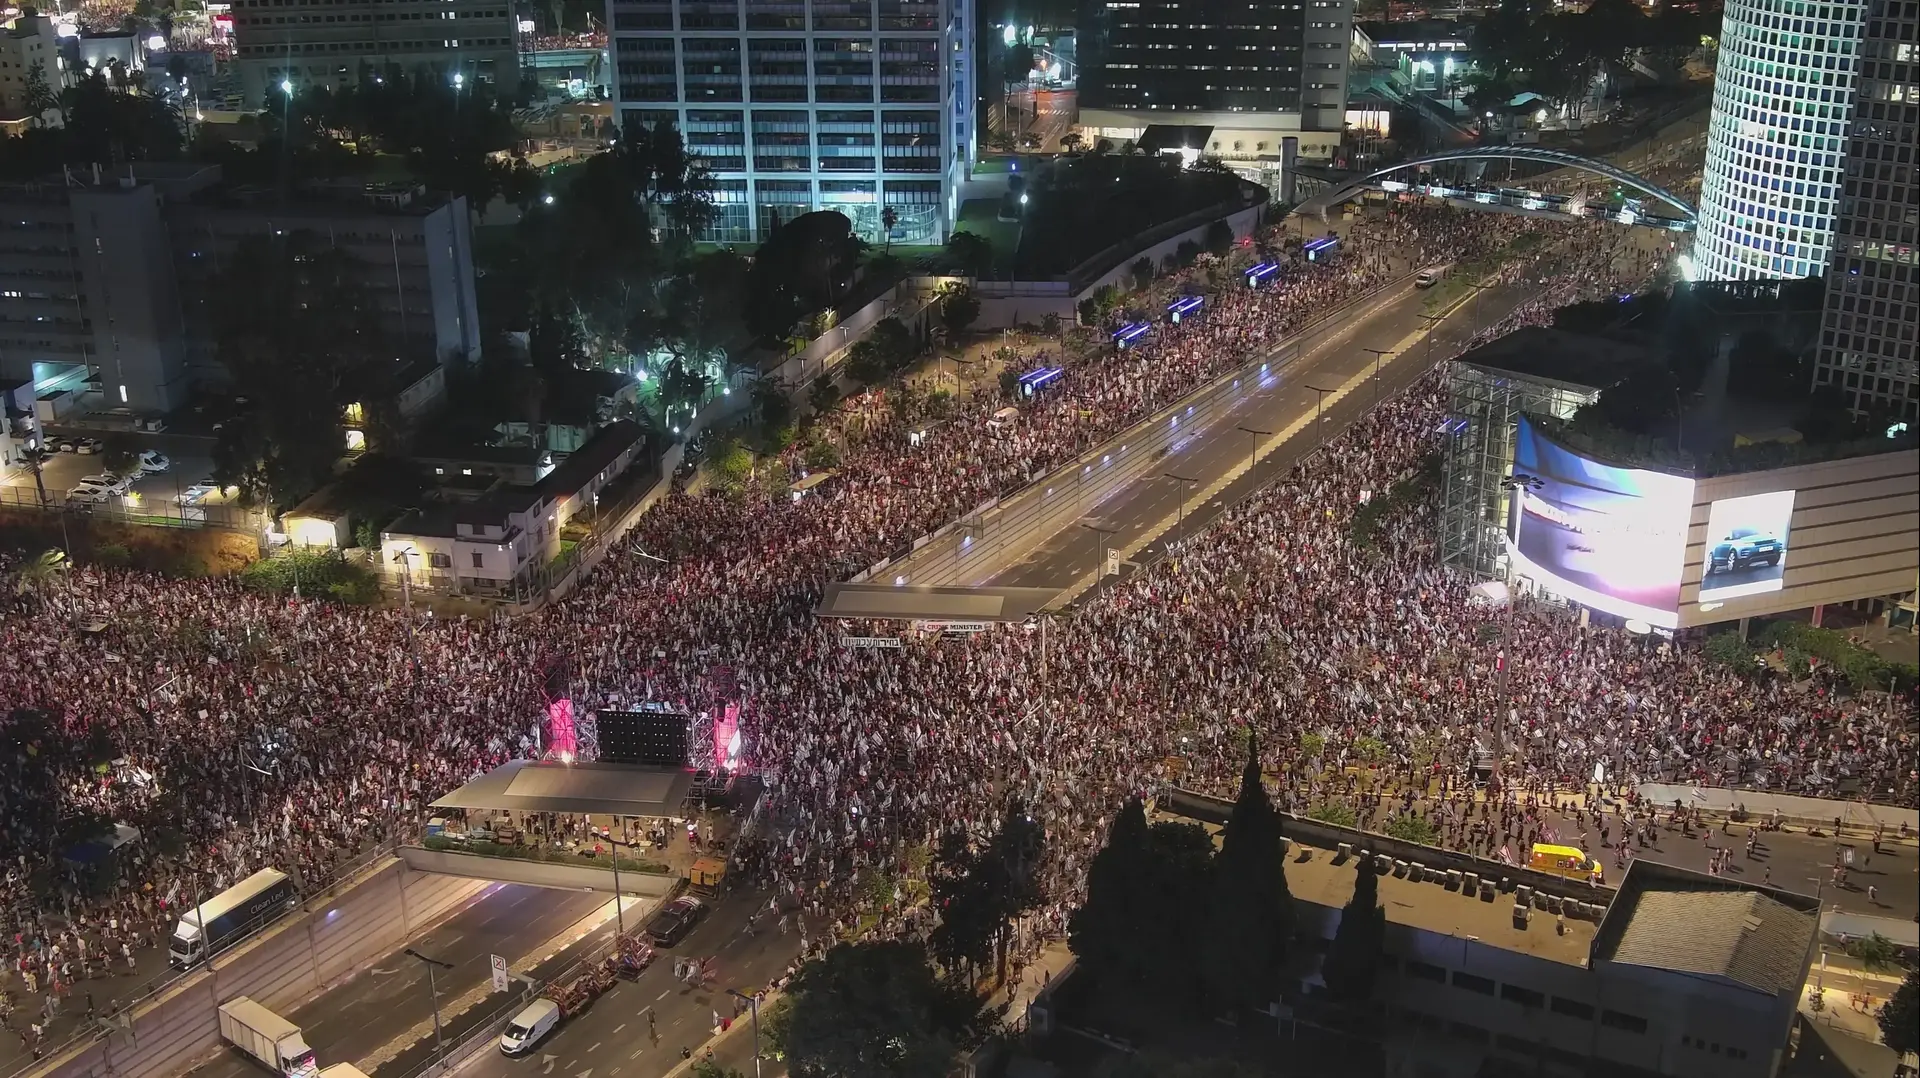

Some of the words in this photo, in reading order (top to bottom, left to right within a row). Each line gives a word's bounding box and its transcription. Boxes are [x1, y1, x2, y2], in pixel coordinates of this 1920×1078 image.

[873, 638, 899, 647] בחירות
[250, 899, 270, 914] Clean
[271, 888, 283, 902] Led
